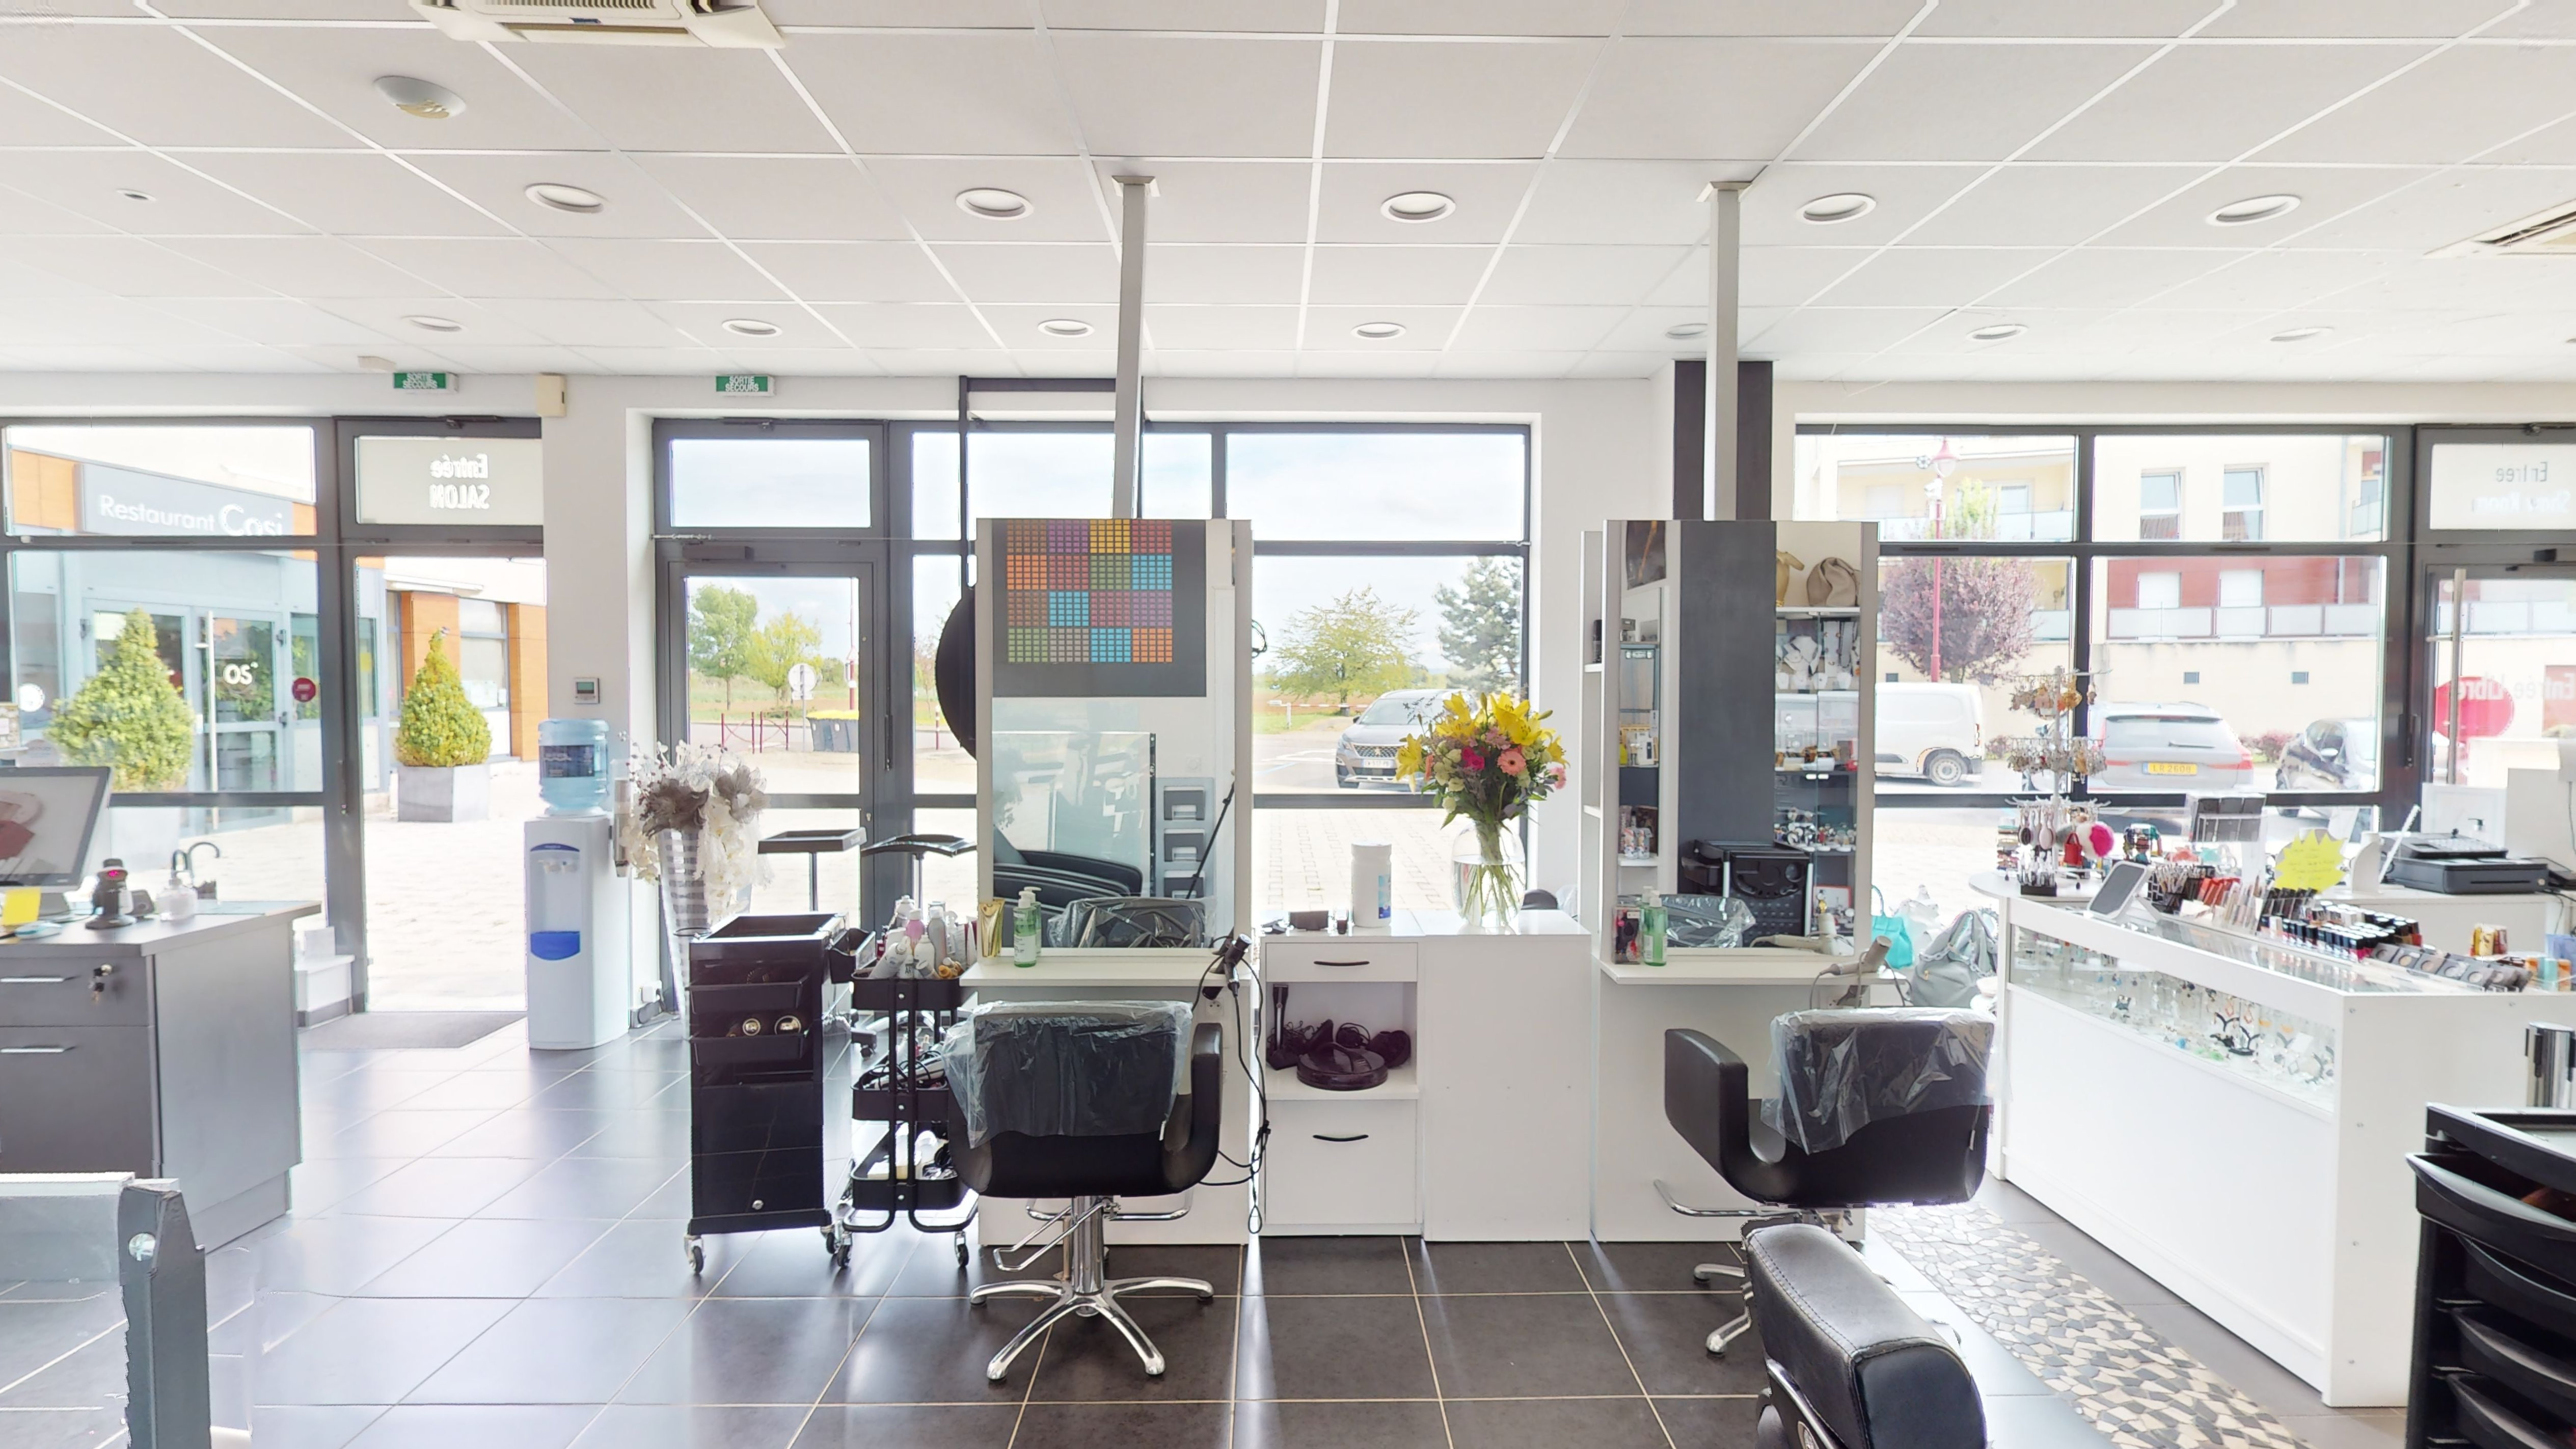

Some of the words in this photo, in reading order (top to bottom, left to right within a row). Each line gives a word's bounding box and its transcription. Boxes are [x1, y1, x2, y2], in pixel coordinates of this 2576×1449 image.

[729, 376, 754, 385] SORTIE
[725, 383, 759, 392] SECOURS
[98, 495, 215, 531] Restaurant
